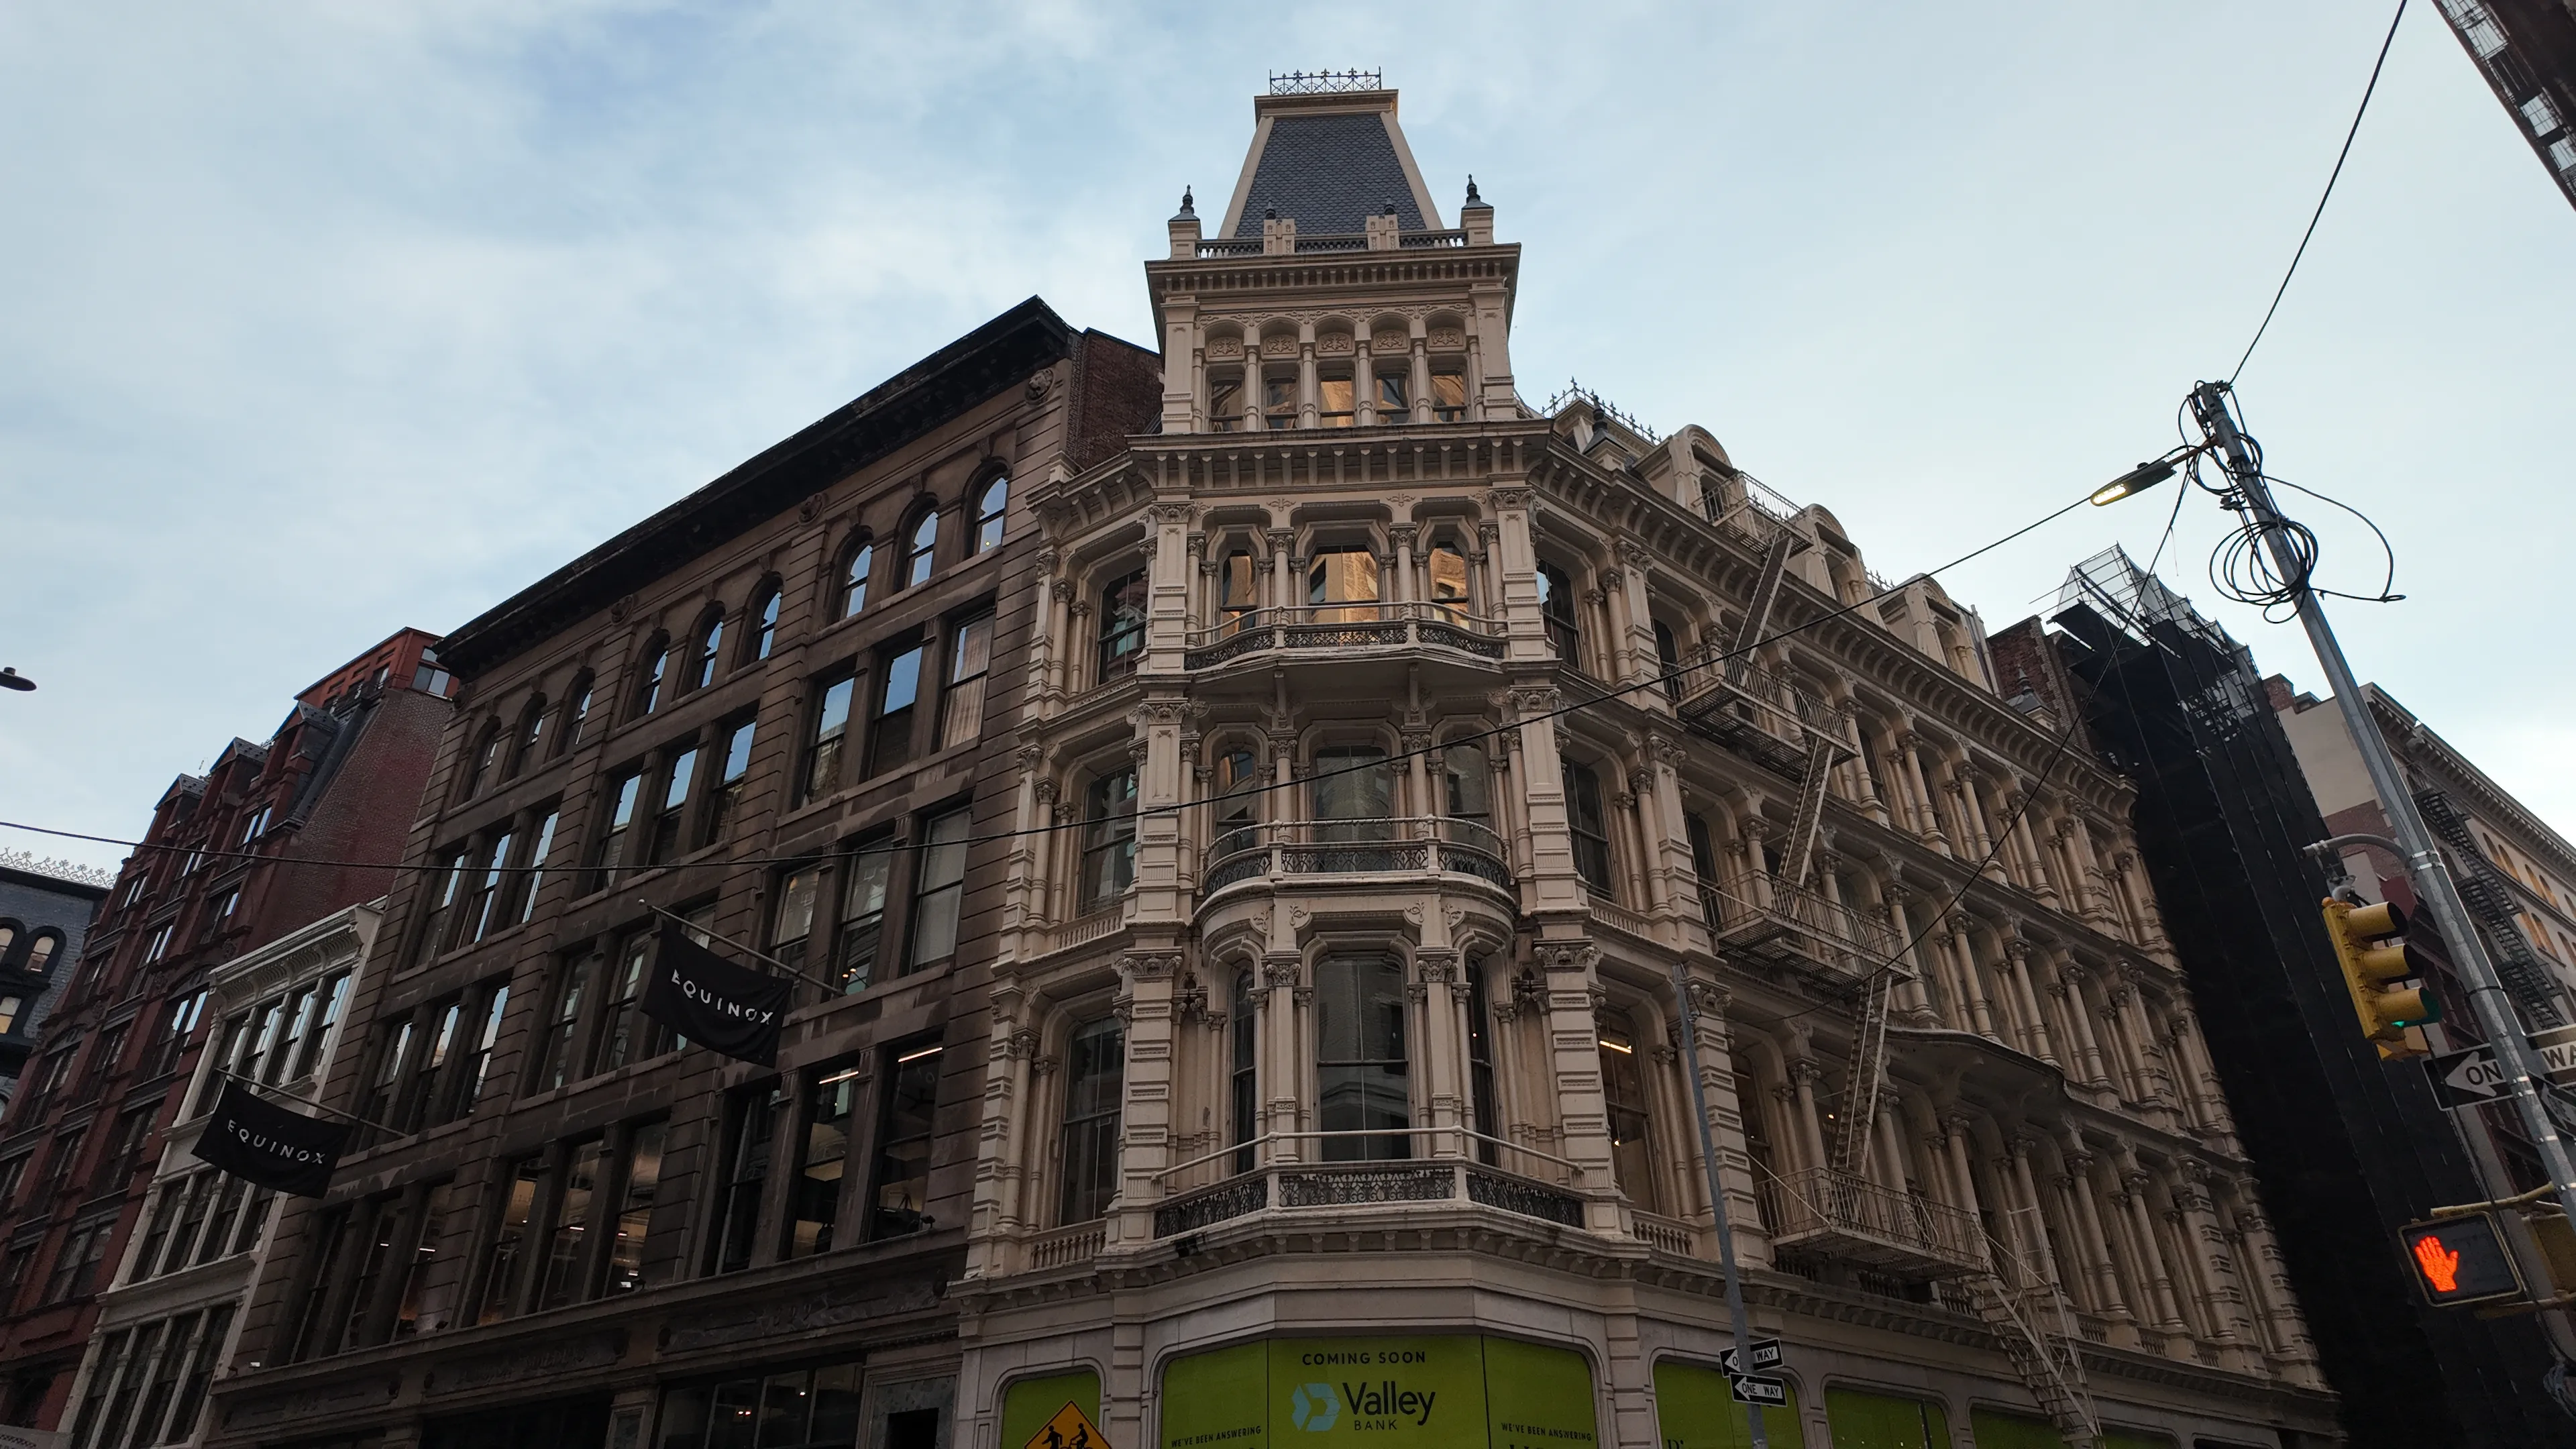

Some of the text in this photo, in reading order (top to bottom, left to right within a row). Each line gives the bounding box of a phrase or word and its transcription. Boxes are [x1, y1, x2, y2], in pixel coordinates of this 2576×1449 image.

[672, 969, 773, 1025] EQUINOX
[2465, 1061, 2504, 1085] ON
[227, 1119, 325, 1164] EQUINOX
[1302, 1351, 1426, 1365] COMING SOON
[1756, 1348, 1774, 1361] WAY
[1741, 1383, 1779, 1397] ONE WAY
[1342, 1381, 1436, 1426] Valley
[1354, 1419, 1397, 1431] BANK
[1501, 1422, 1592, 1441] WE'VE BEEN ANSWERING
[1171, 1426, 1261, 1448] WE'VE BEEN ANSWERING
